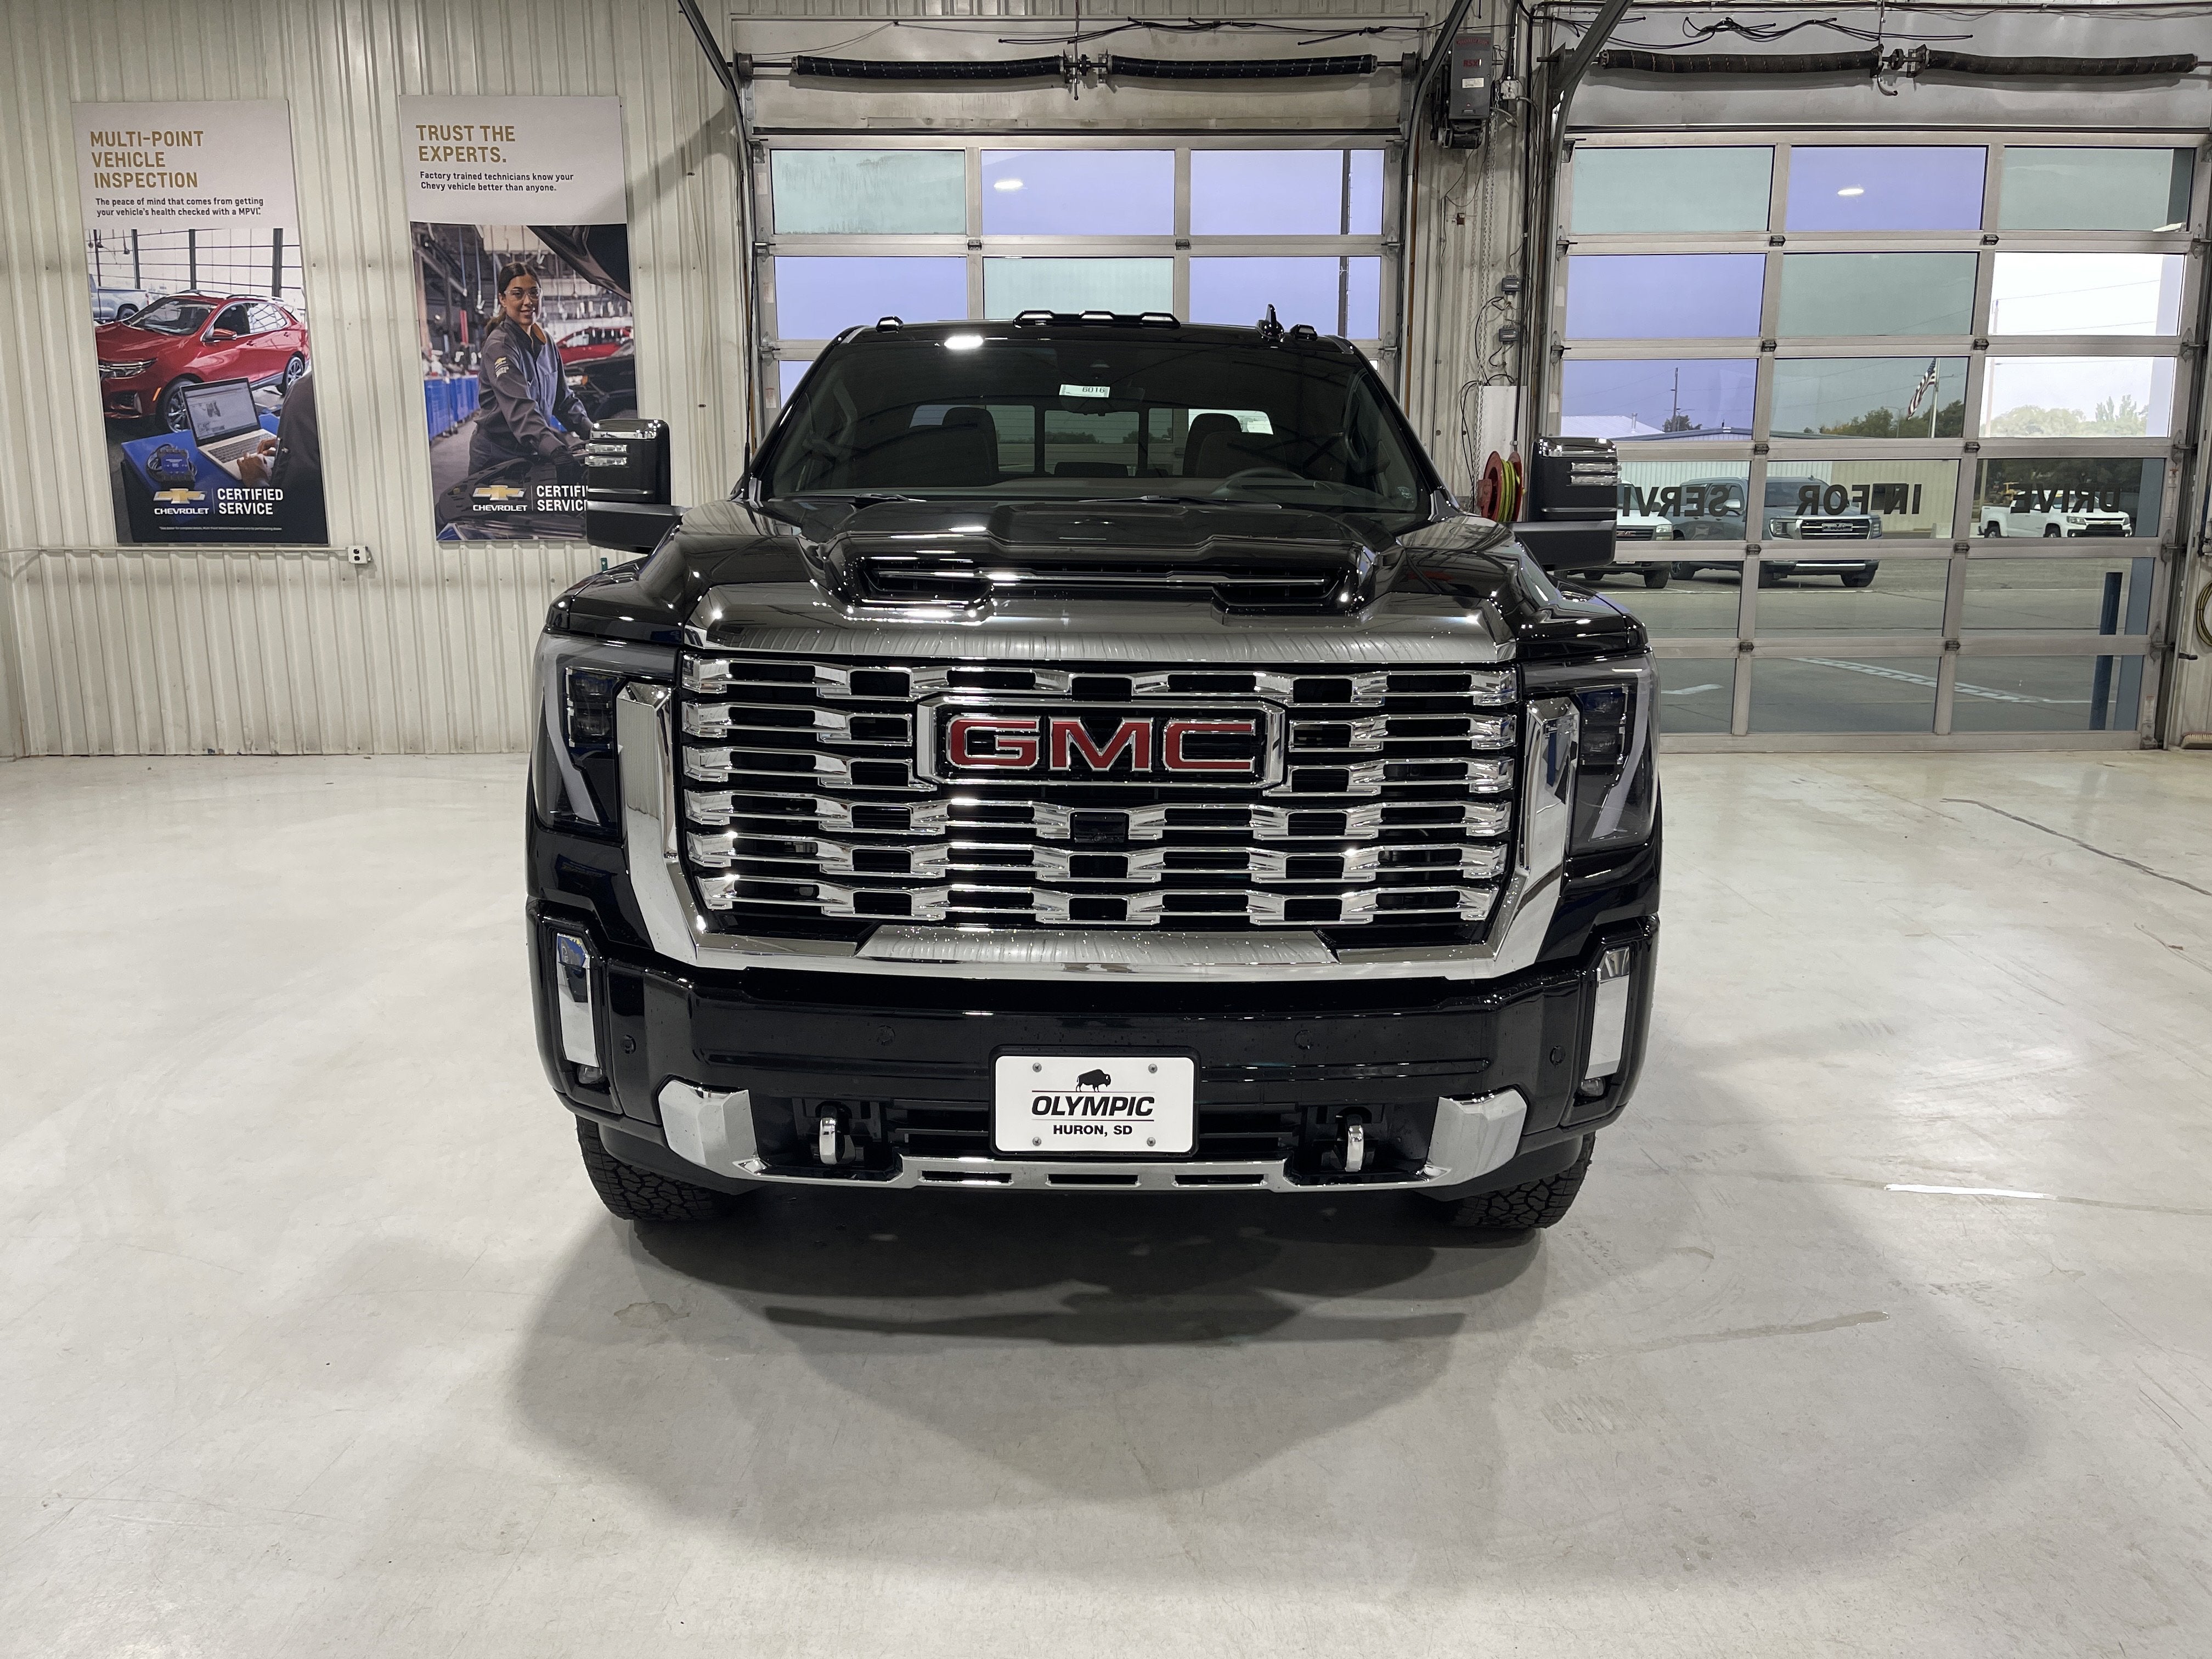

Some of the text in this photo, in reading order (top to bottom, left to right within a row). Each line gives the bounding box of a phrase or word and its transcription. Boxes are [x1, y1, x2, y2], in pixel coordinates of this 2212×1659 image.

[90, 131, 204, 146] MULTI-POINT
[416, 125, 516, 142] TRUST THE
[92, 151, 166, 167] VEHICLE
[419, 146, 506, 163] EXPERTS.
[94, 172, 198, 188] INSPECTION
[420, 171, 451, 181] Factory
[484, 173, 530, 181] technicians
[421, 182, 445, 190] Chevy
[235, 198, 263, 206] getting
[217, 488, 284, 501] CERTIFIED
[537, 485, 588, 497] CERTIFI
[218, 502, 273, 515] SERVICE
[946, 714, 1256, 772] GMC
[1031, 1096, 1155, 1116] OLYMPIC
[1053, 1125, 1132, 1137] HURON, SD
